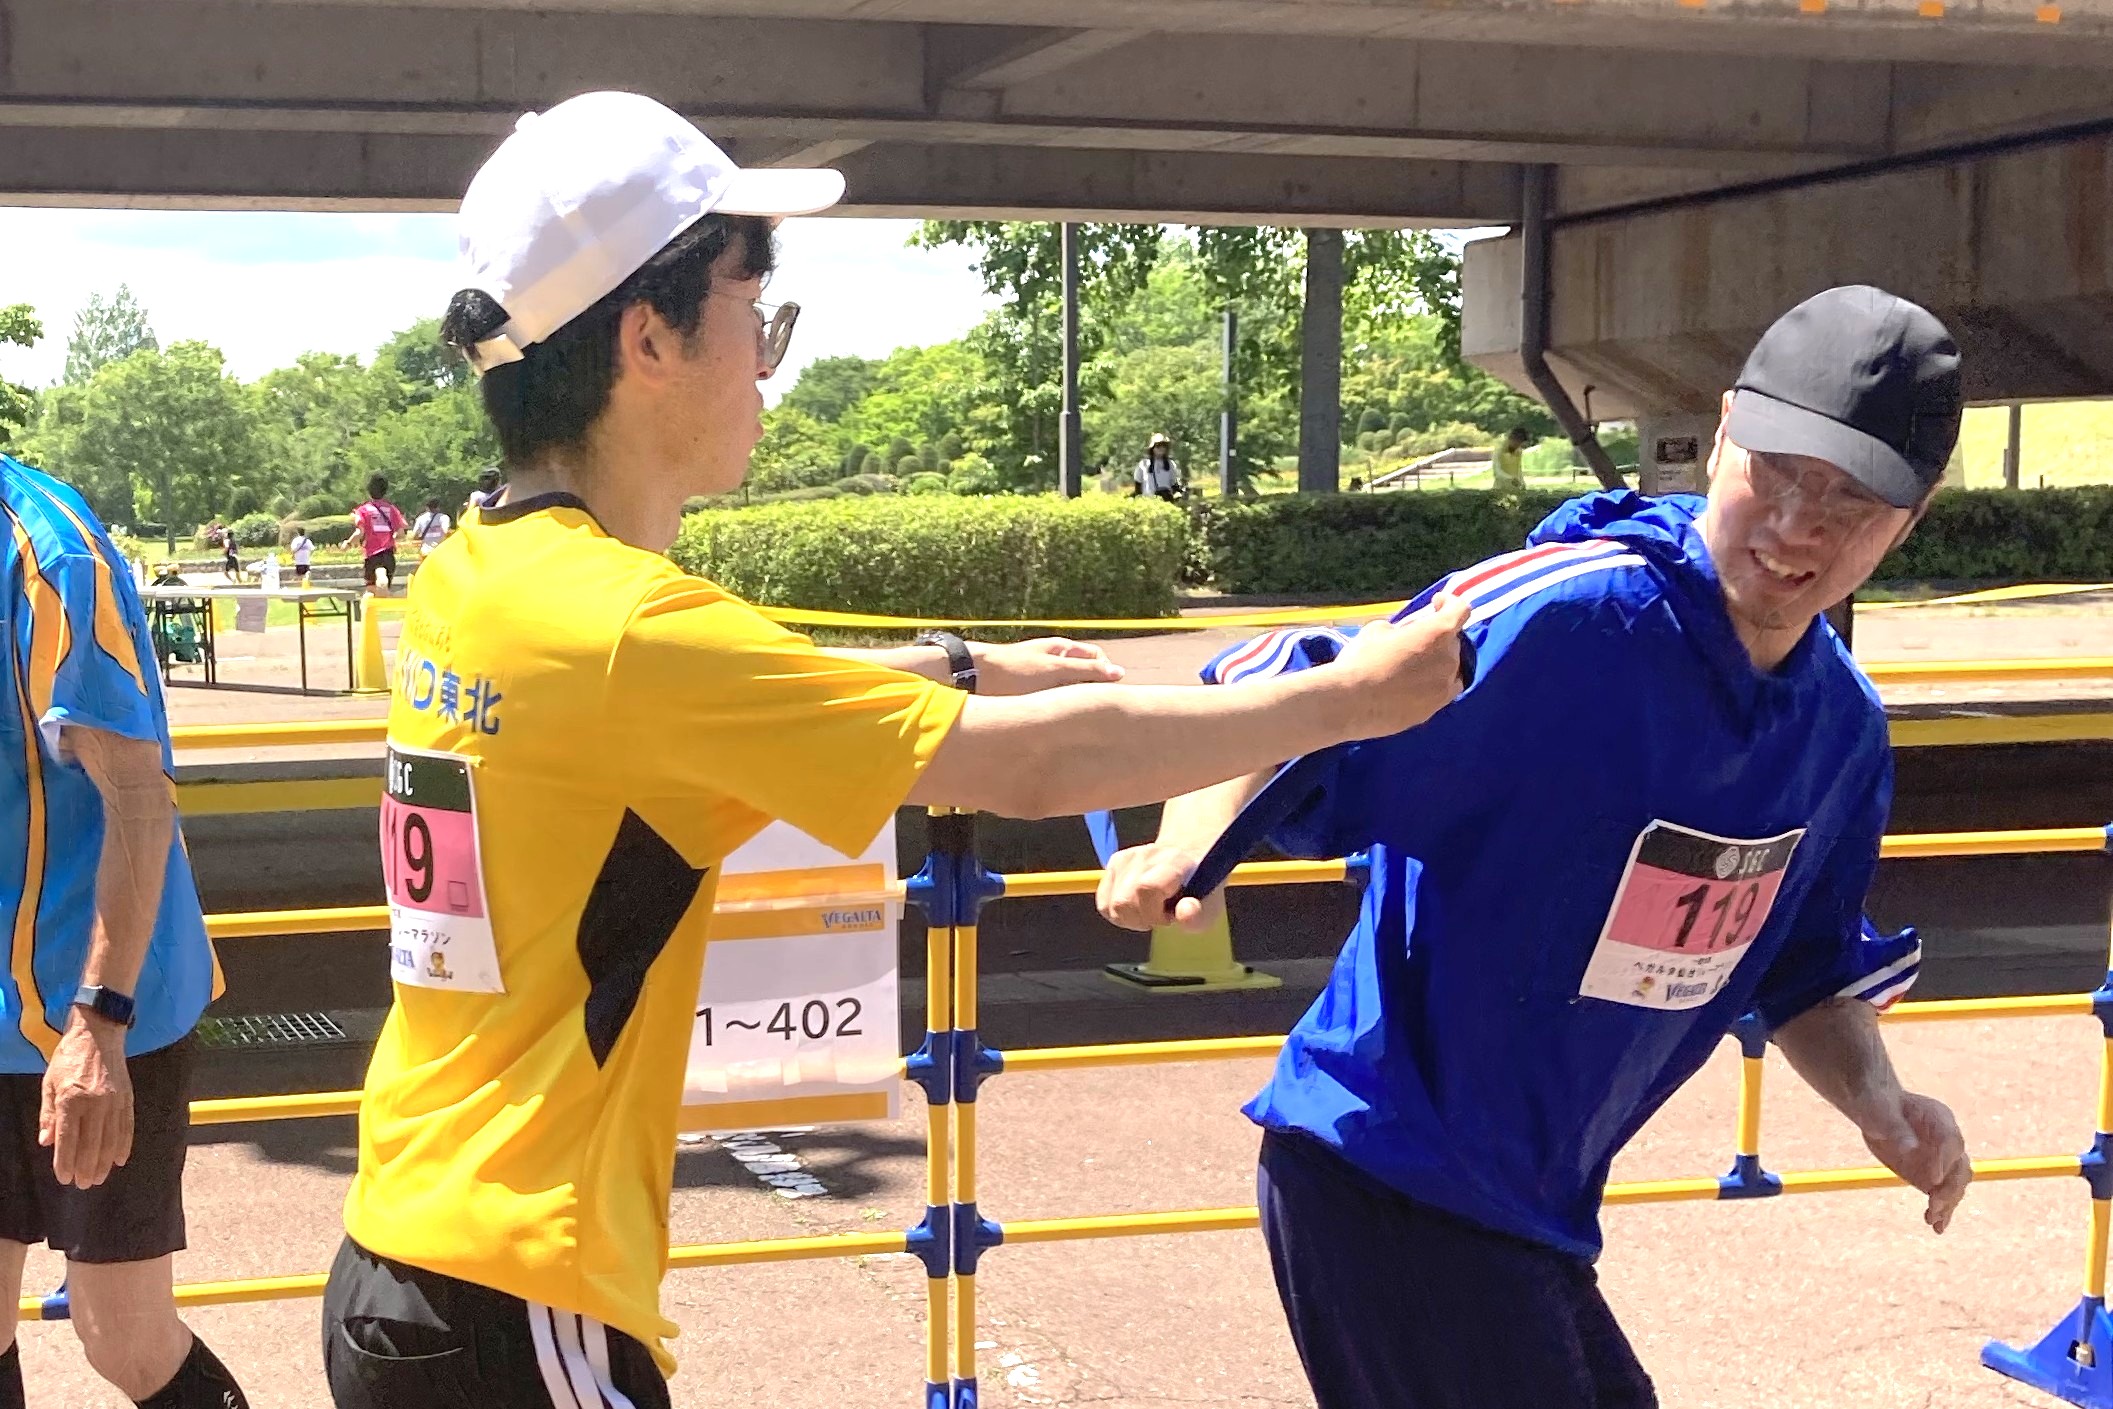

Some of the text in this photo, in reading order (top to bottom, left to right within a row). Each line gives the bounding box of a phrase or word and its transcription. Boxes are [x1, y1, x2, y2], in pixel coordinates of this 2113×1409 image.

[821, 910, 881, 928] VEGALTA
[1676, 883, 1760, 949] 119
[398, 928, 451, 945] ーマラソン
